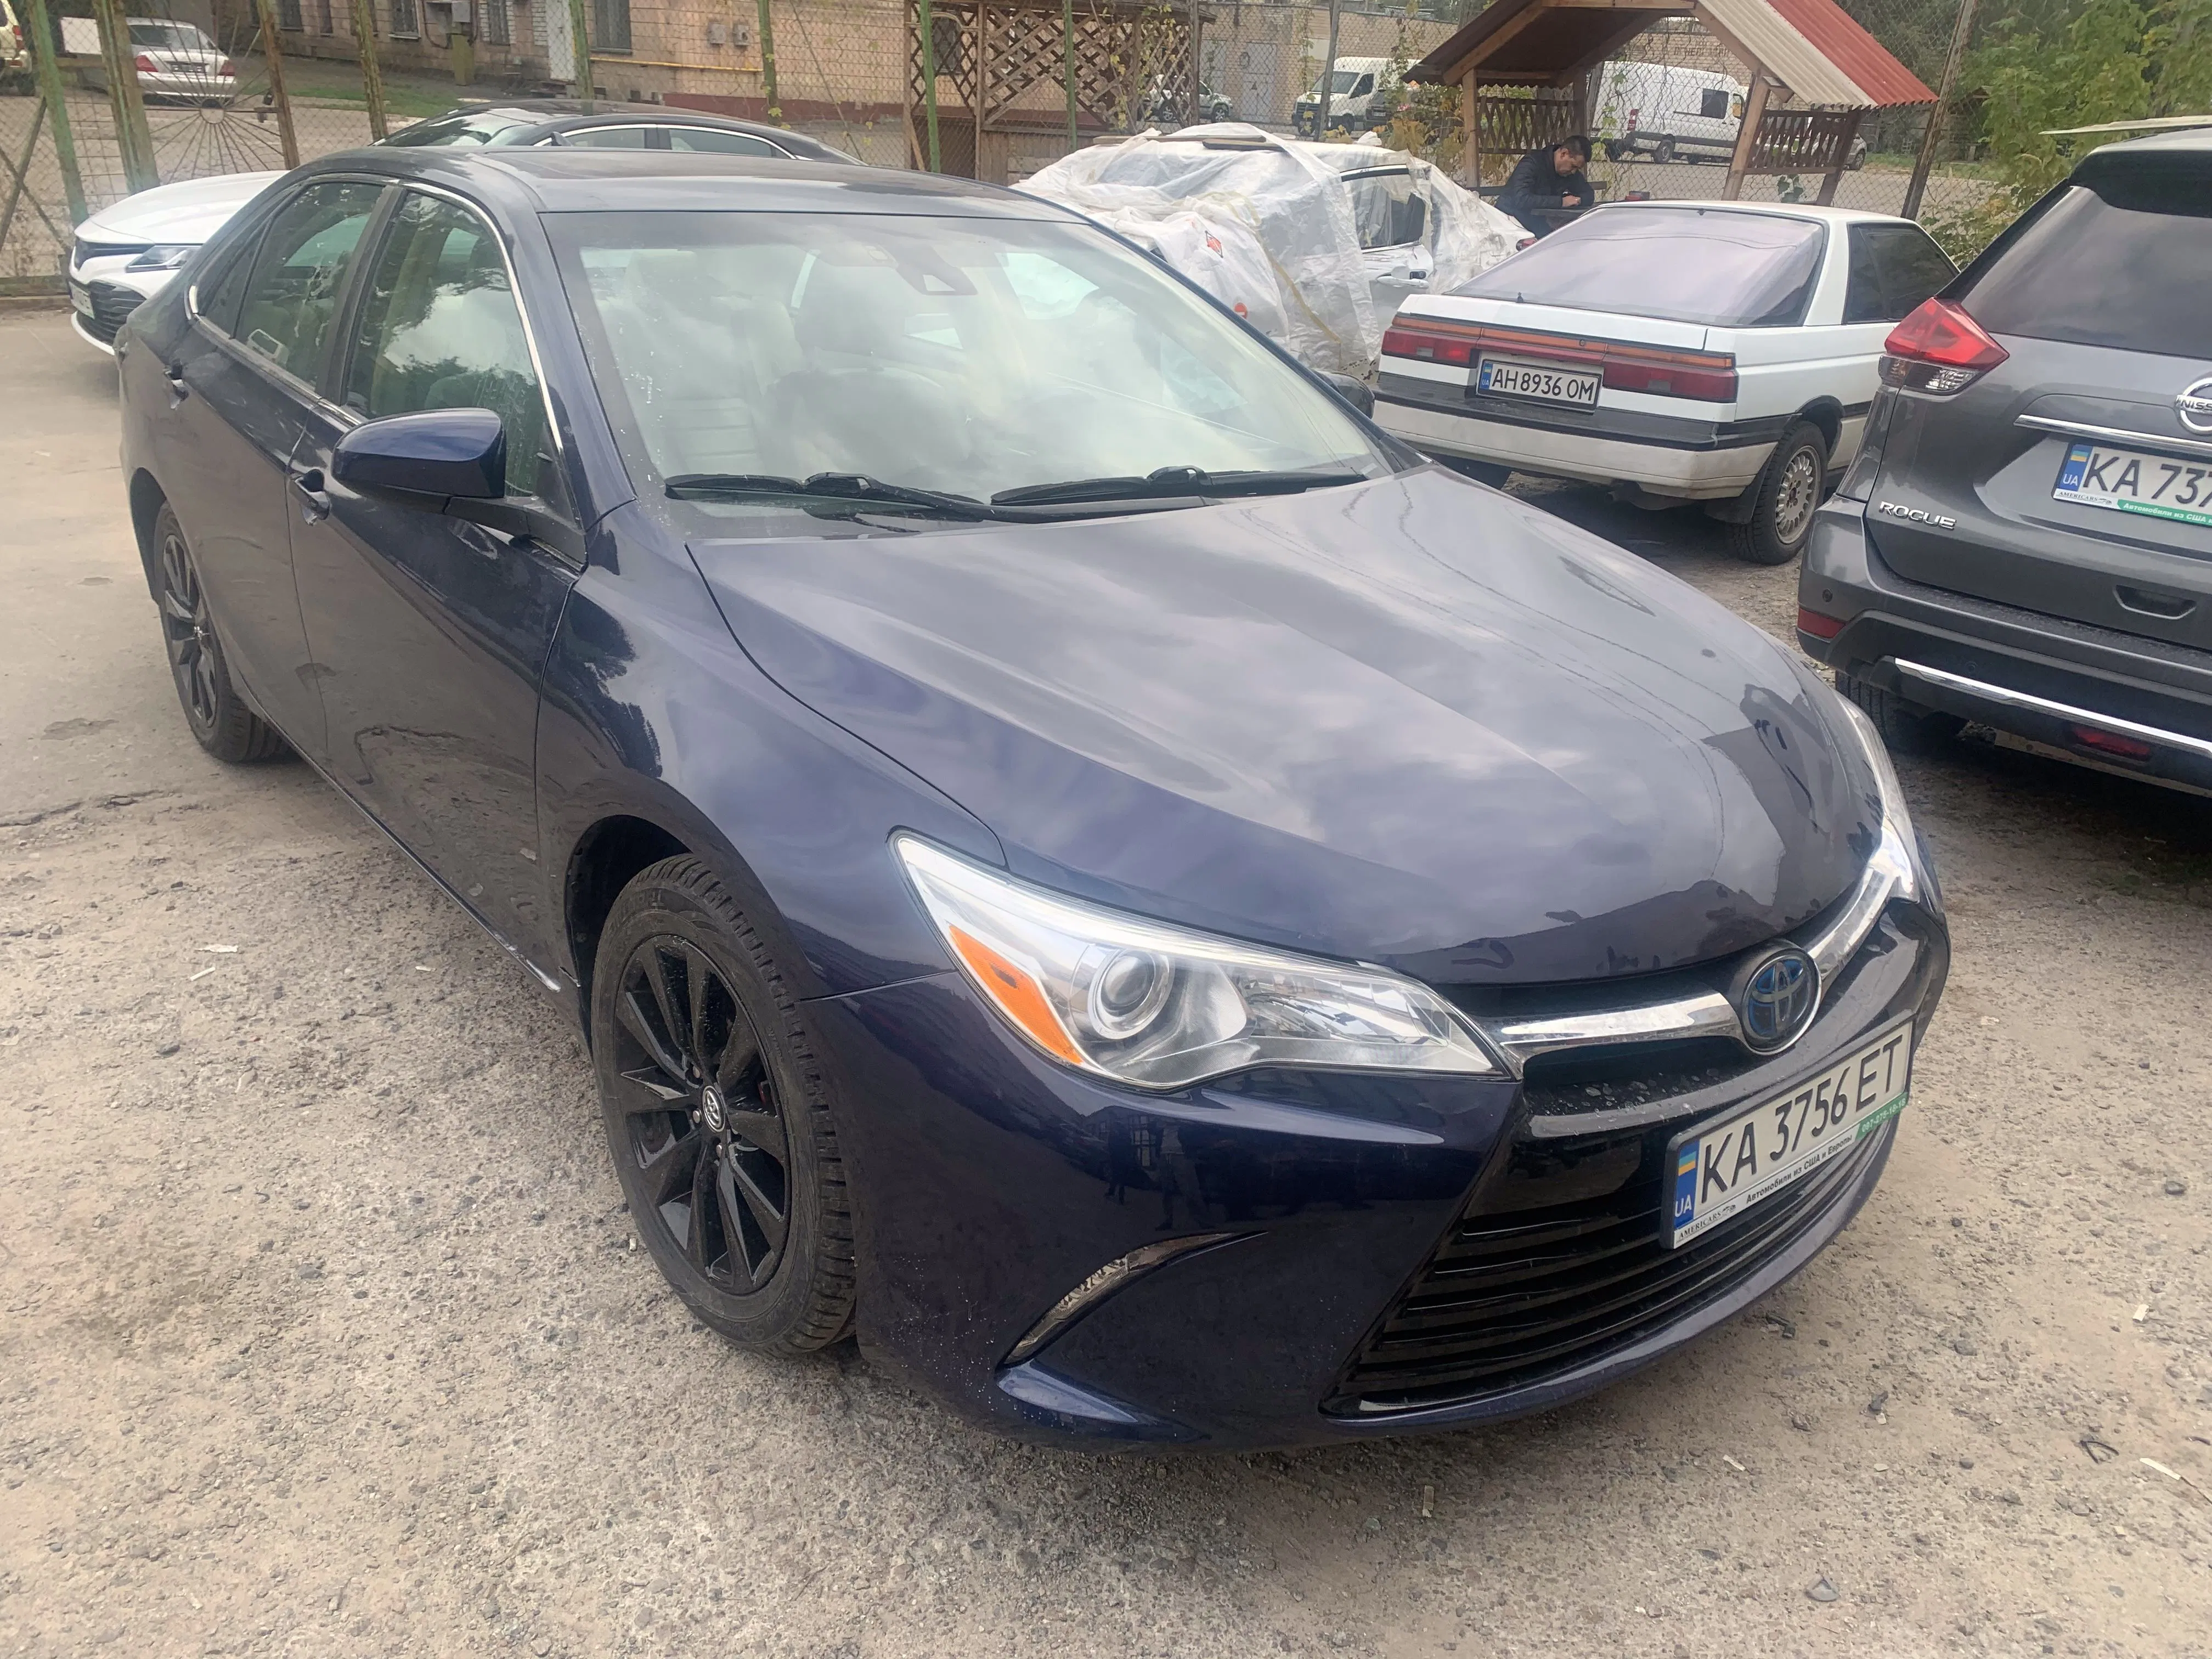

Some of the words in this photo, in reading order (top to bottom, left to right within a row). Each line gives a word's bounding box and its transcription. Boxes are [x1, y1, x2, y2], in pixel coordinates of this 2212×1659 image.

[1492, 369, 1519, 390] AH
[1521, 373, 1562, 396] 8936
[1567, 379, 1594, 401] OM
[2063, 473, 2078, 486] UA
[2083, 454, 2141, 496] KA
[2059, 492, 2098, 501] AMERICARS
[1879, 501, 1957, 531] ROGUE
[2123, 503, 2172, 516] Автомобили
[2186, 514, 2206, 522] США
[1701, 1122, 1757, 1204] KA
[1770, 1066, 1852, 1161] 3756
[1856, 1034, 1903, 1113] ET
[1746, 1172, 1791, 1204] Автомобили
[1794, 1167, 1802, 1177] из
[1804, 1154, 1820, 1170] США
[1828, 1135, 1852, 1155] Европы
[1675, 1194, 1692, 1217] UA
[1679, 1210, 1722, 1238] AMERICARS
